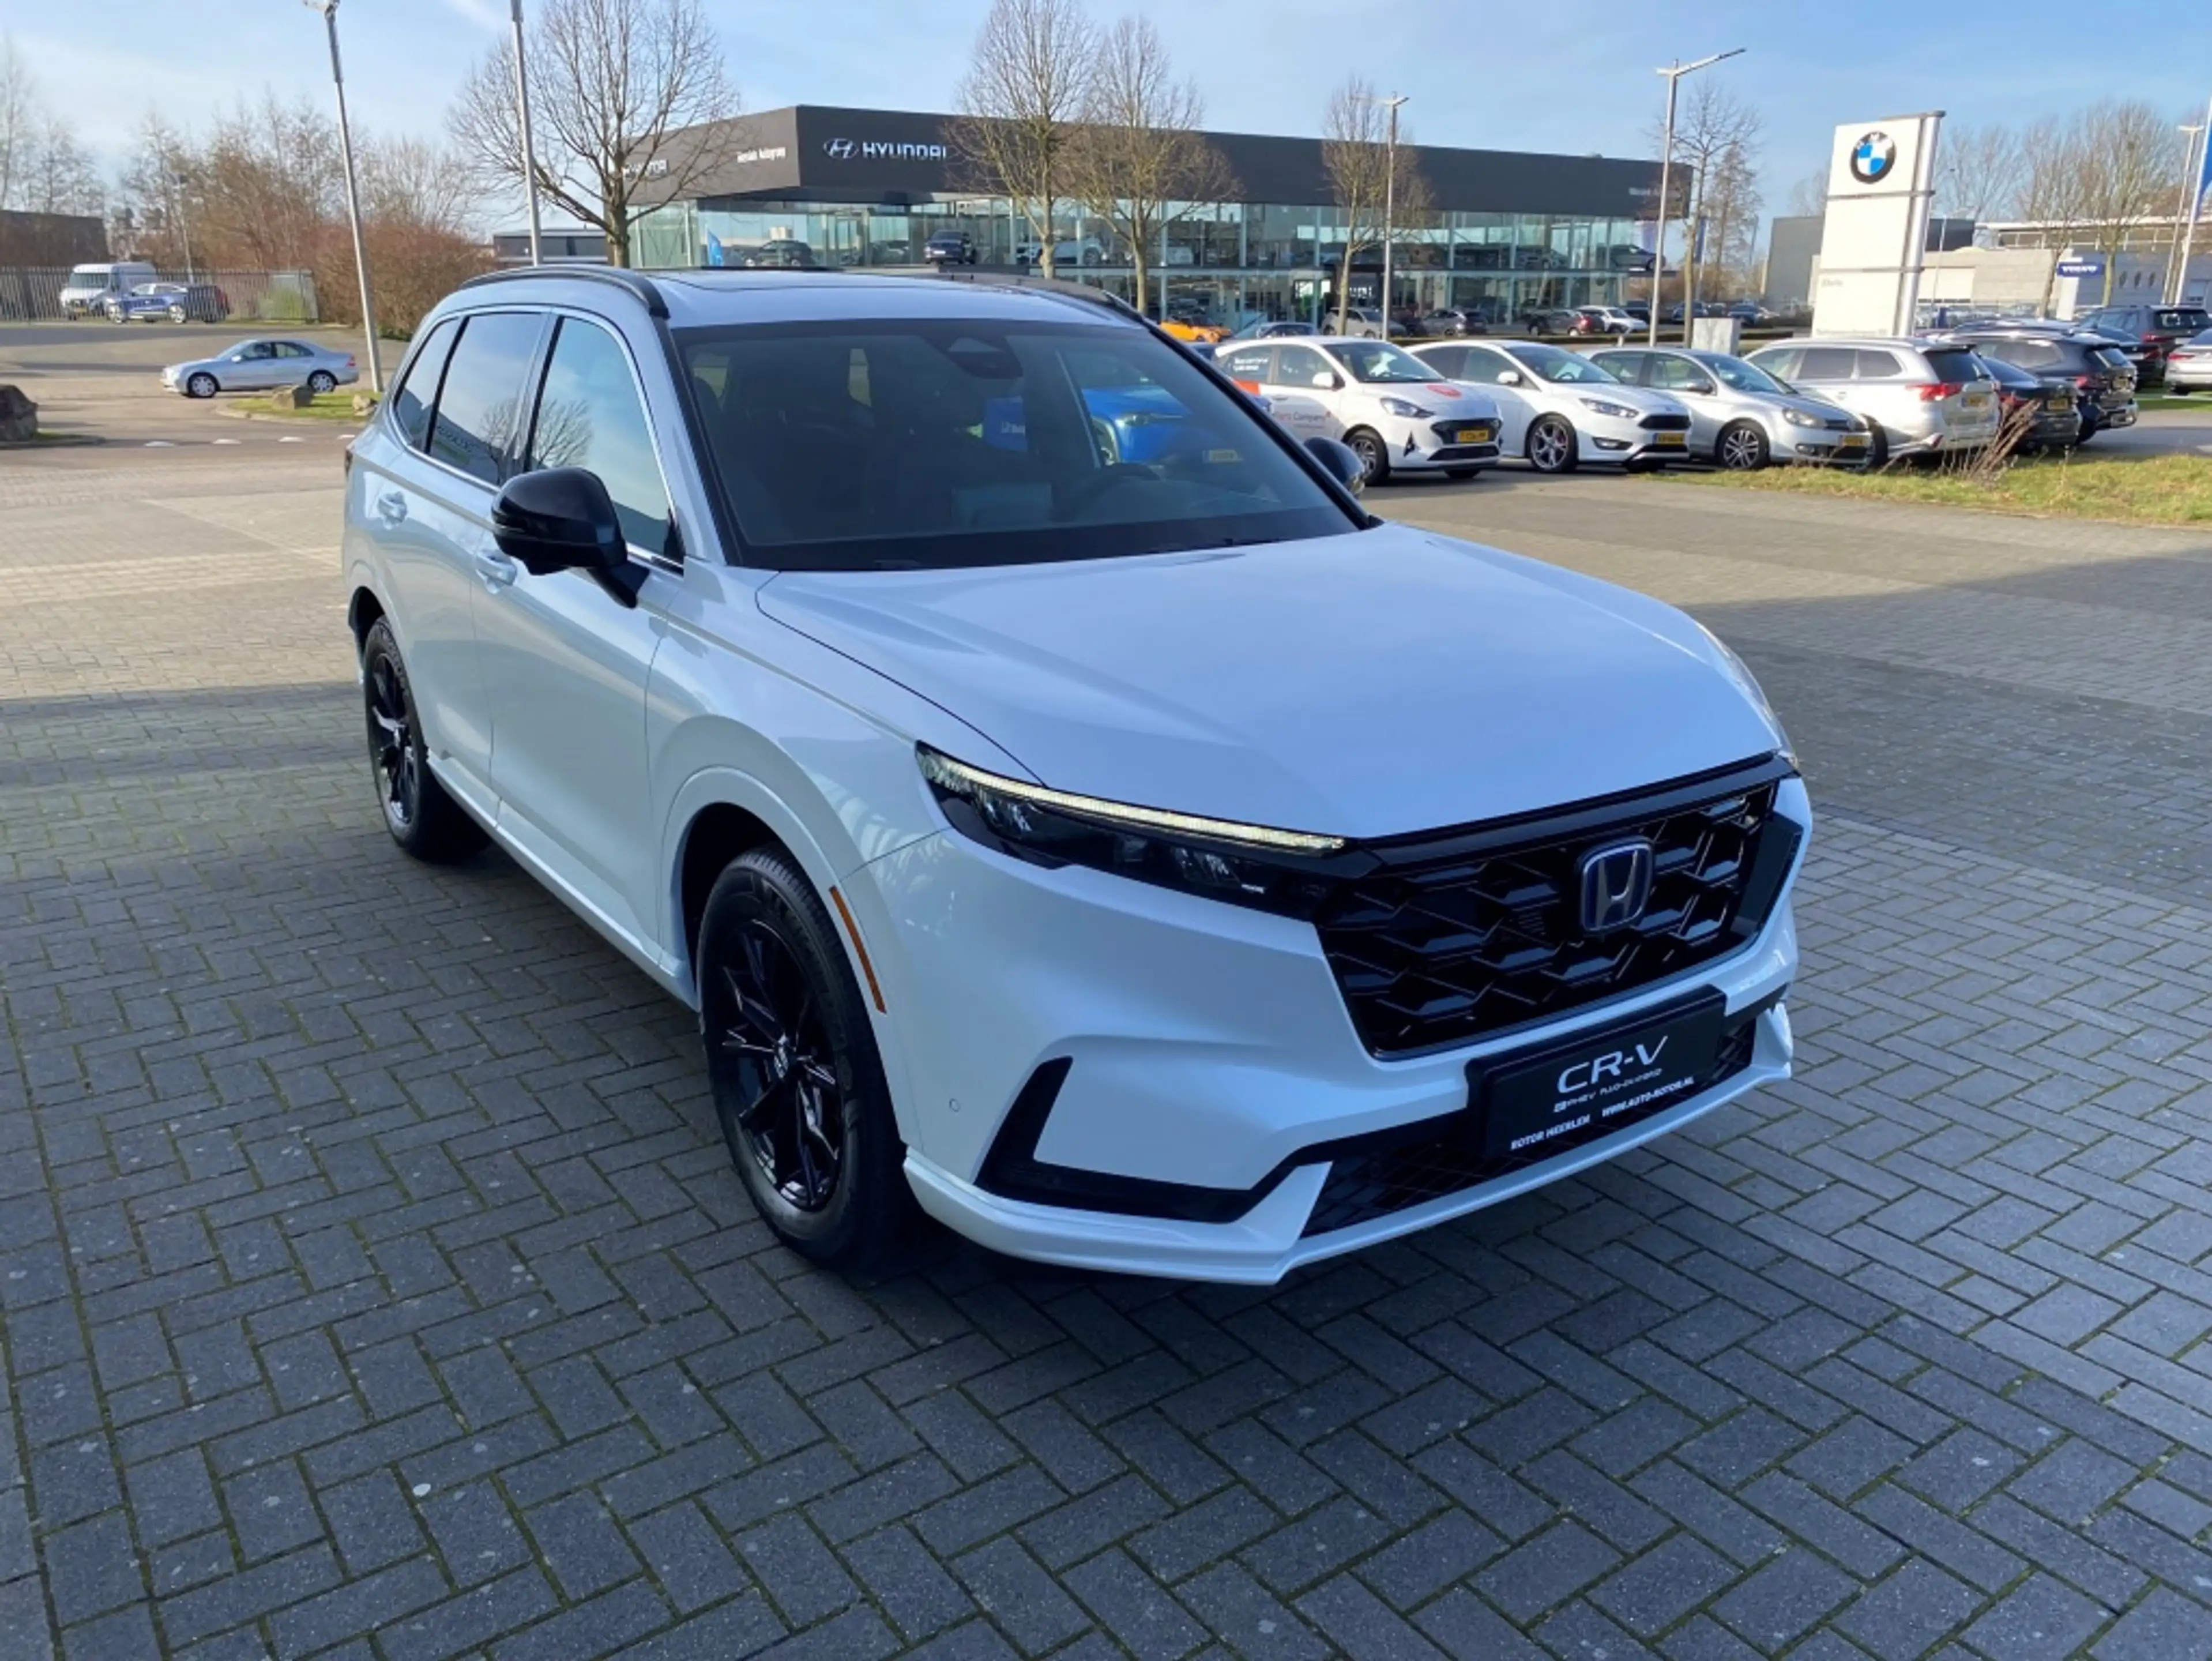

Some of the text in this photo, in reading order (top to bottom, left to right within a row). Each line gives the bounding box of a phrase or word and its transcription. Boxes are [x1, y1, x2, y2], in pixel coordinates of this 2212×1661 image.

[863, 141, 946, 161] HYUNDAI
[1558, 1036, 1668, 1093] CR-V
[1546, 1114, 1590, 1138] HEERLEN
